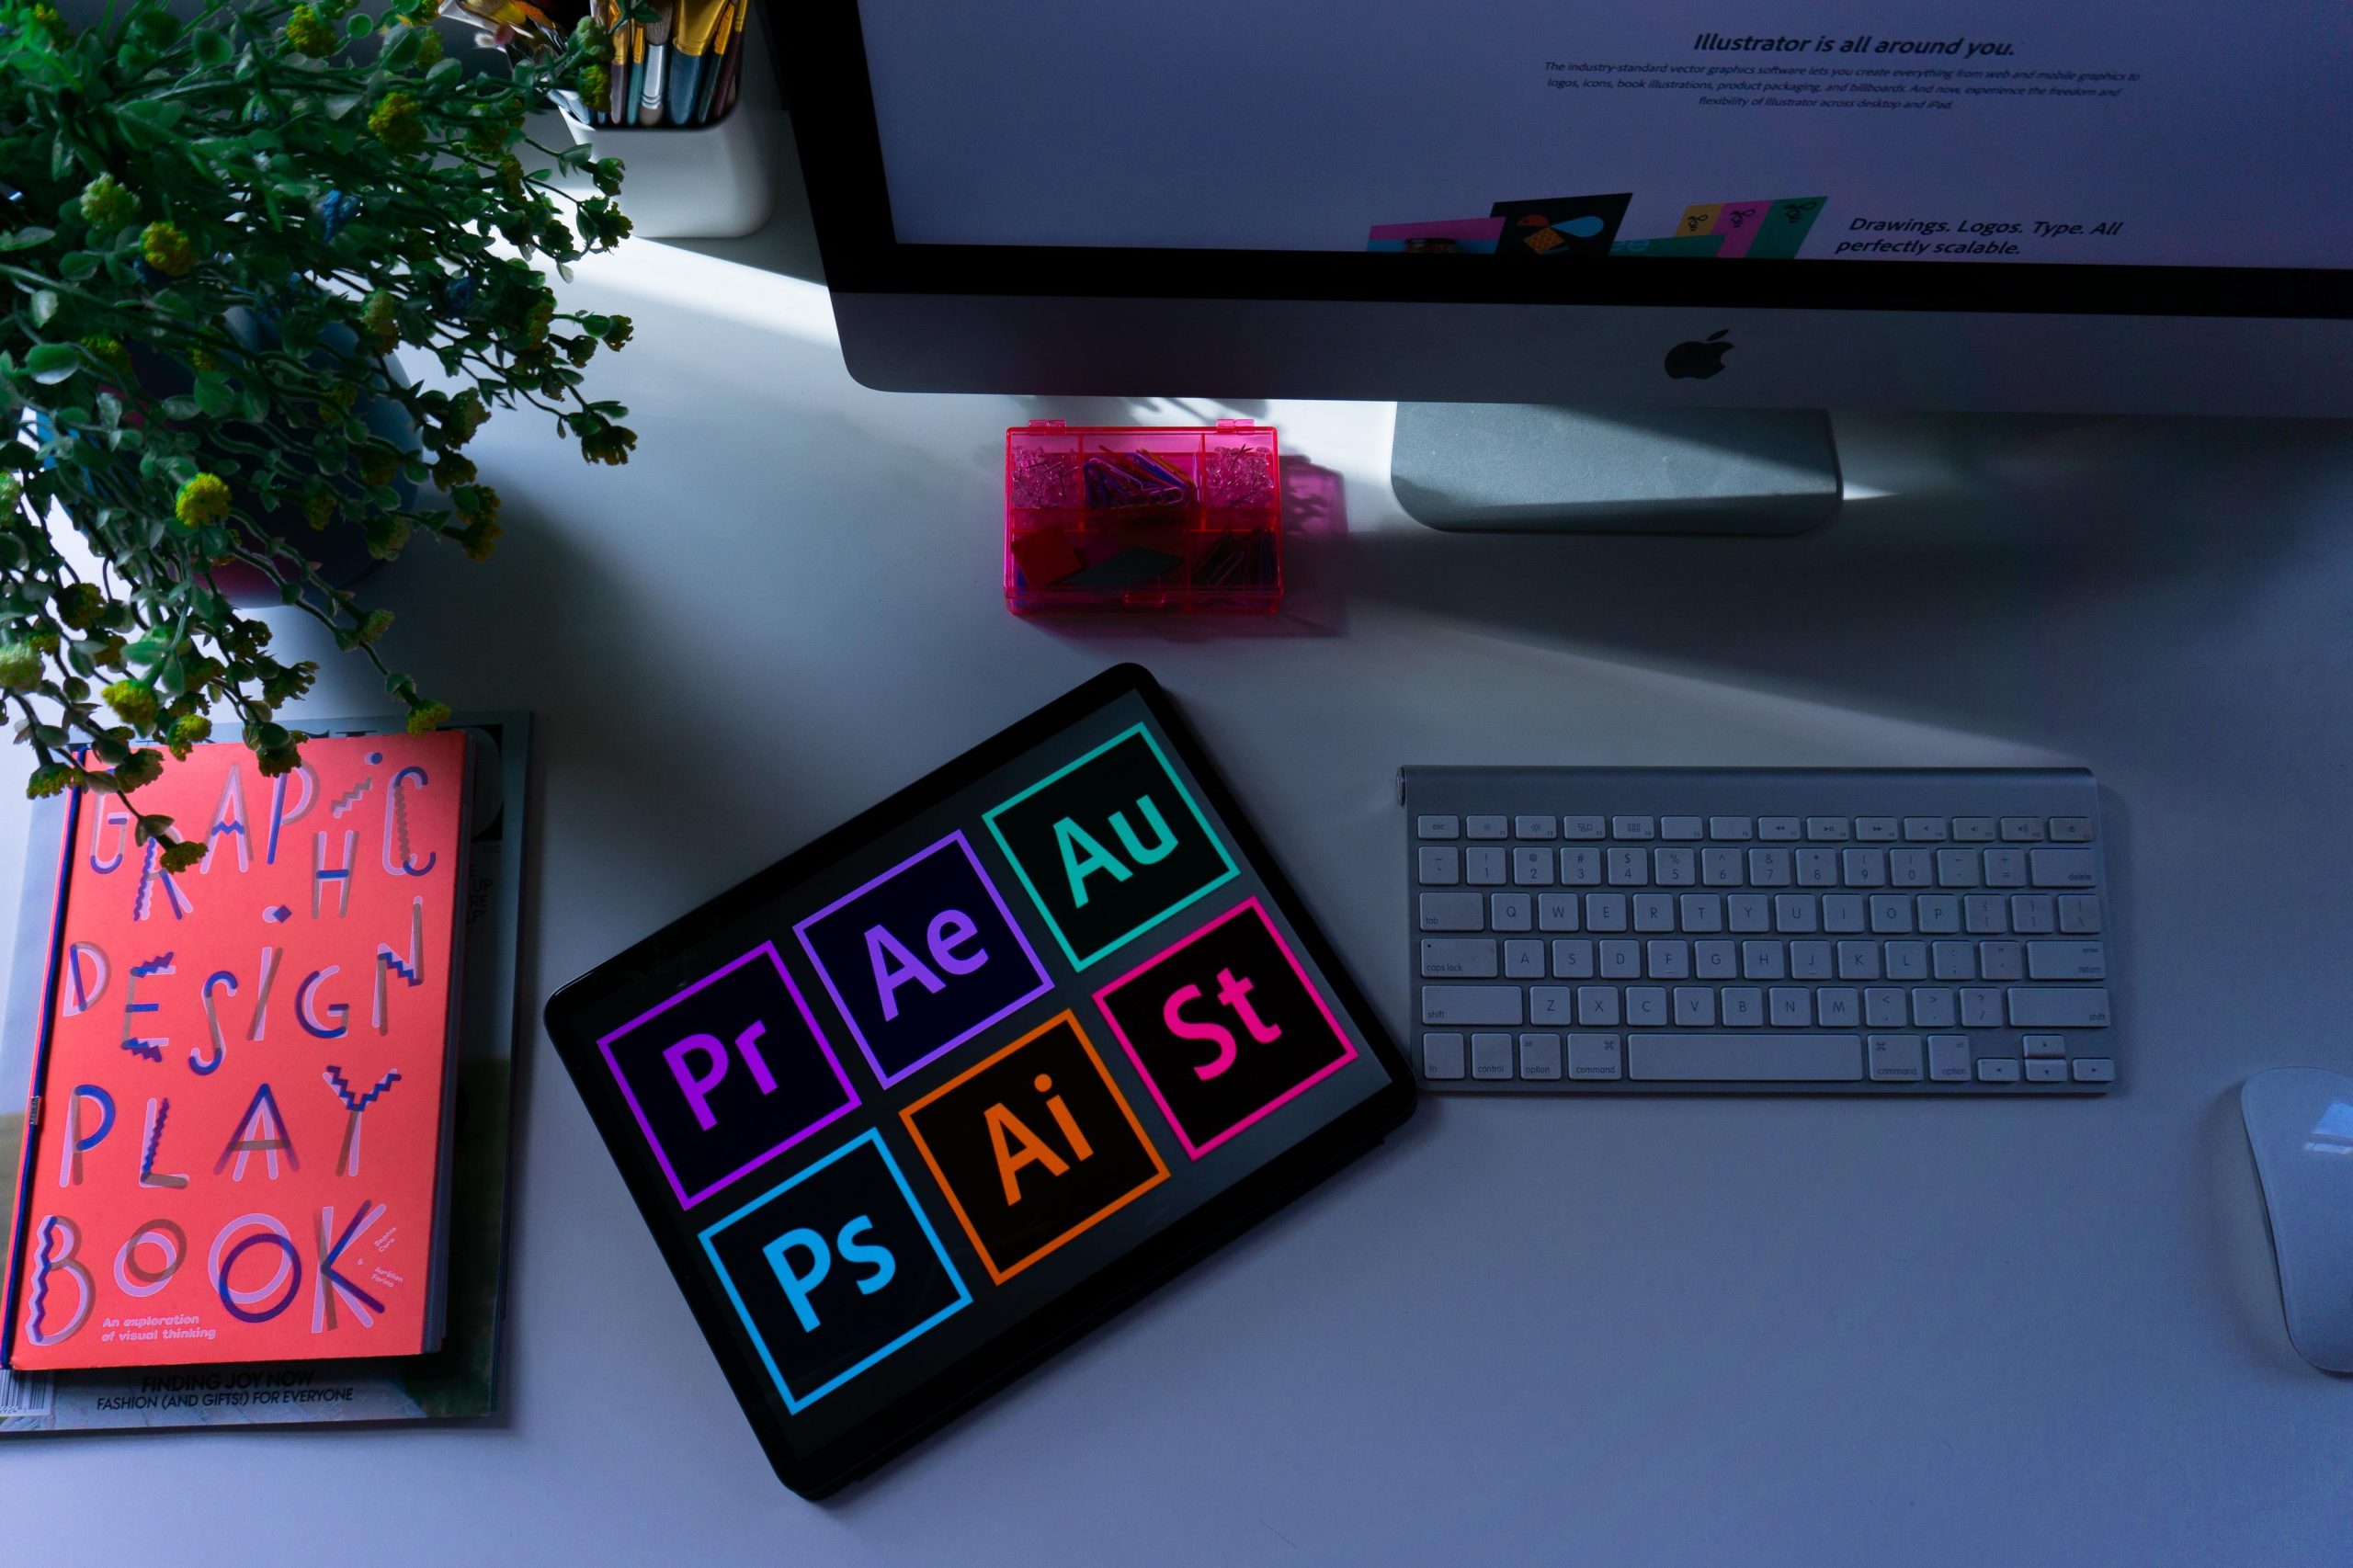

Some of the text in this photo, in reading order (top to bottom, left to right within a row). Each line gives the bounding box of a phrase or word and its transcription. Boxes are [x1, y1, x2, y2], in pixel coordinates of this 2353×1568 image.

[1693, 32, 2015, 60] Illustrator is all around you.
[1544, 61, 1565, 73] The
[1567, 62, 1668, 75] industry-standard
[1669, 64, 1705, 74] vector
[1707, 63, 1756, 77] graphics
[1757, 64, 1806, 76] software
[1808, 65, 1828, 76] lets
[1830, 68, 1854, 79] you
[1855, 67, 1891, 77] create
[1893, 68, 1954, 81] everything
[1956, 68, 1984, 79] from
[1985, 69, 2011, 80] web
[2013, 70, 2036, 80] and
[2037, 70, 2075, 81] mobile
[2075, 71, 2127, 84] graphics
[1547, 77, 1580, 90] logos,
[1582, 78, 1615, 89] icons,
[1617, 77, 1646, 89] book
[1648, 78, 1714, 90] illustrations,
[1716, 80, 1762, 93] product
[1763, 81, 1824, 94] packaging,
[1825, 82, 1848, 93] and
[1849, 83, 1905, 93] billboards.
[1910, 84, 1931, 94] And
[1699, 96, 1953, 110] flexibility of Illustrator across desktop and iPad.
[1848, 217, 2125, 238] Drawings. Logos. Type. All
[1836, 238, 2021, 256] perfectly scalable.
[1052, 793, 1178, 909] Au
[1483, 867, 1490, 879] 1
[1529, 868, 1538, 880] 2
[1576, 868, 1586, 880] 3
[1624, 868, 1632, 879] 4
[1672, 868, 1679, 881] 5
[1719, 869, 1727, 881] 6
[1766, 869, 1774, 880] 7
[1813, 869, 1822, 881] 8
[1860, 869, 1869, 880] 9
[1907, 869, 1916, 881] 0
[1506, 905, 1518, 918] Q
[1552, 906, 1565, 918] W
[1603, 905, 1610, 918] E
[1650, 906, 1658, 919] R
[1697, 906, 1706, 919] T
[1744, 906, 1753, 918] Y
[1791, 907, 1802, 920] U
[1886, 907, 1897, 920] O
[1934, 907, 1943, 920] P
[1426, 916, 1438, 926] tab
[864, 907, 989, 1022] Ae
[1520, 952, 1530, 964] A
[1568, 952, 1576, 965] S
[1616, 952, 1626, 965] D
[1665, 952, 1673, 965] F
[1711, 953, 1722, 966] G
[1758, 953, 1769, 965] H
[1808, 954, 1814, 966] J
[1854, 953, 1864, 965] K
[1902, 954, 1911, 967] L
[1427, 963, 1462, 973] caps lock
[61, 895, 424, 1076] DESIGN
[1546, 999, 1555, 1012] Z
[1594, 1000, 1604, 1012] X
[1642, 1000, 1651, 1013] C
[1689, 1000, 1699, 1012] V
[1738, 1000, 1747, 1013] B
[1784, 1000, 1796, 1013] N
[1832, 1000, 1846, 1013] M
[1161, 966, 1282, 1081] St
[1428, 1063, 1438, 1073] fn
[1526, 1065, 1551, 1075] option
[1942, 1067, 1967, 1077] option
[662, 1020, 779, 1131] Pr
[58, 1064, 403, 1189] PLAY
[983, 1073, 1094, 1206] Ai
[25, 1199, 387, 1346] BOOK
[762, 1214, 897, 1334] Ps
[102, 1313, 200, 1329] An exploration
[101, 1326, 217, 1342] of visual thinking
[142, 1369, 316, 1394] FINDING JOY NOW
[97, 1387, 354, 1411] FASHION (AND GIFTS!) FOR EVERYONE
